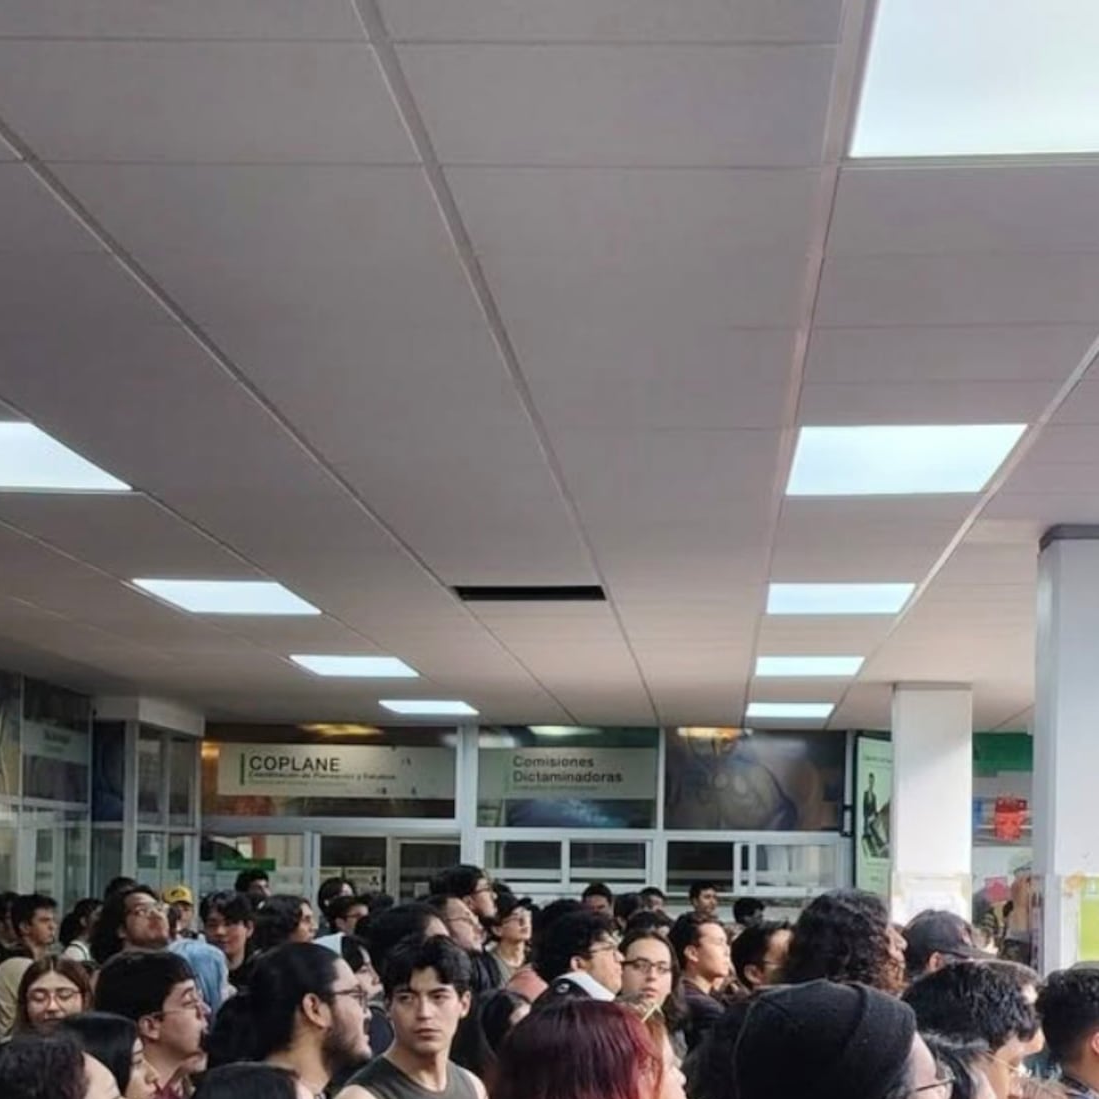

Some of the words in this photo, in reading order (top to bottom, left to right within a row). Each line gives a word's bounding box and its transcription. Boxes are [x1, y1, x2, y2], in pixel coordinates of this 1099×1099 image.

[249, 755, 341, 772] COPLANE
[512, 755, 594, 768] Comisiones
[512, 770, 623, 783] Dictaminadoras
